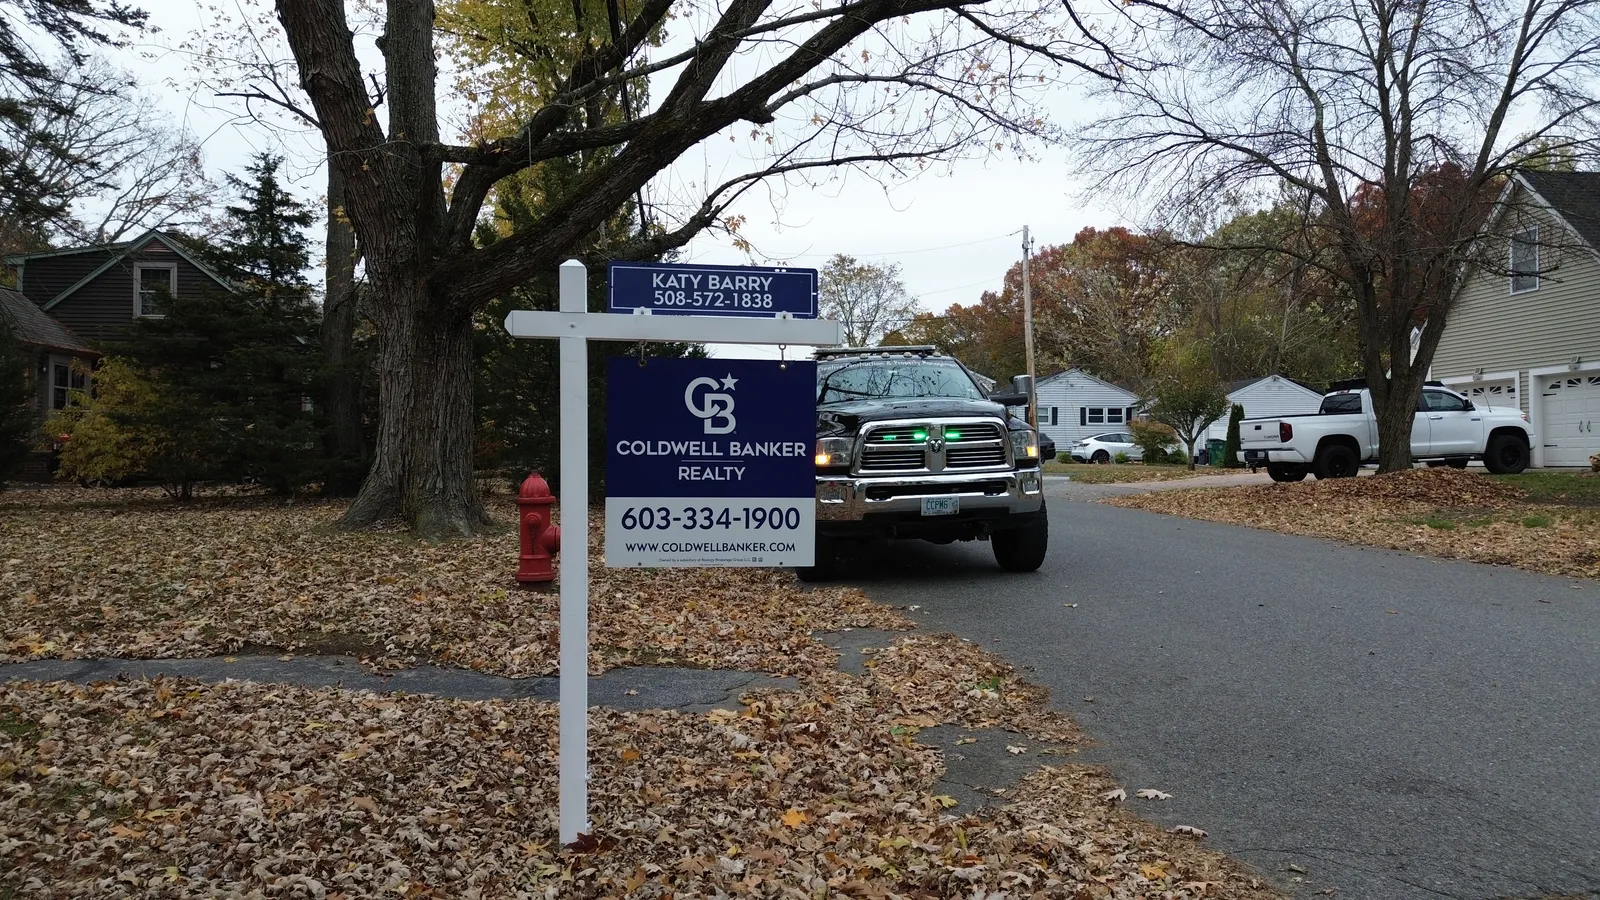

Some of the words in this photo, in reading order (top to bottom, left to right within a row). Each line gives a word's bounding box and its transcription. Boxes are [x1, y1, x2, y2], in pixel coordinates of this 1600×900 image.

[652, 272, 703, 289] KATY
[708, 275, 773, 291] BARRY
[653, 290, 773, 309] 508-572-1838
[616, 440, 724, 456] COLDWELL
[729, 442, 807, 457] BANKER
[678, 466, 746, 481] REALTY
[621, 507, 801, 531] 603-334-1900
[625, 542, 796, 553] WWW.COLDWELLBANKER.COM
